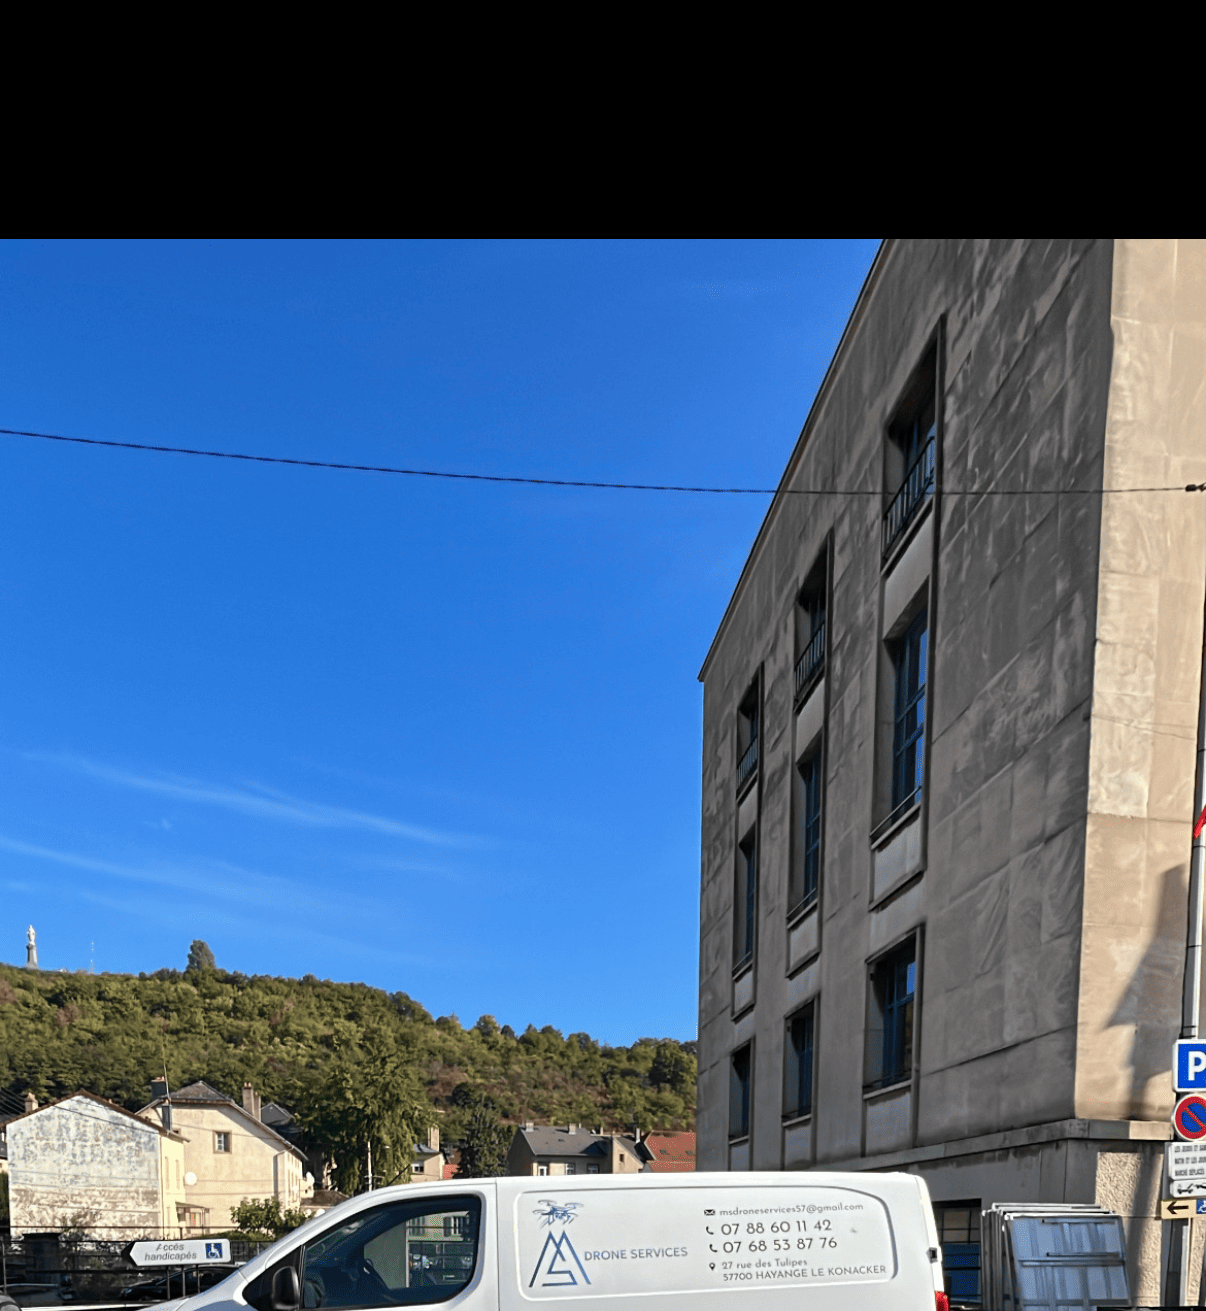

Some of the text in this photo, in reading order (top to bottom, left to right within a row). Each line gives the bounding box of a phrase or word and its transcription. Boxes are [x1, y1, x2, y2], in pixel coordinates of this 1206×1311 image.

[1188, 1051, 1206, 1081] P
[719, 1202, 864, 1216] msdroneservices57@gmail.com
[721, 1219, 832, 1235] 07 88 60 11 42
[723, 1237, 838, 1253] 07 68 53 87 76
[144, 1251, 197, 1262] handicapés
[584, 1247, 688, 1261] DRONE SERVICES
[721, 1261, 733, 1270] 27
[755, 1258, 772, 1268] des
[775, 1257, 808, 1269] Tulipes
[723, 1265, 887, 1281] 57700 HAYANGE LE KONACKER
